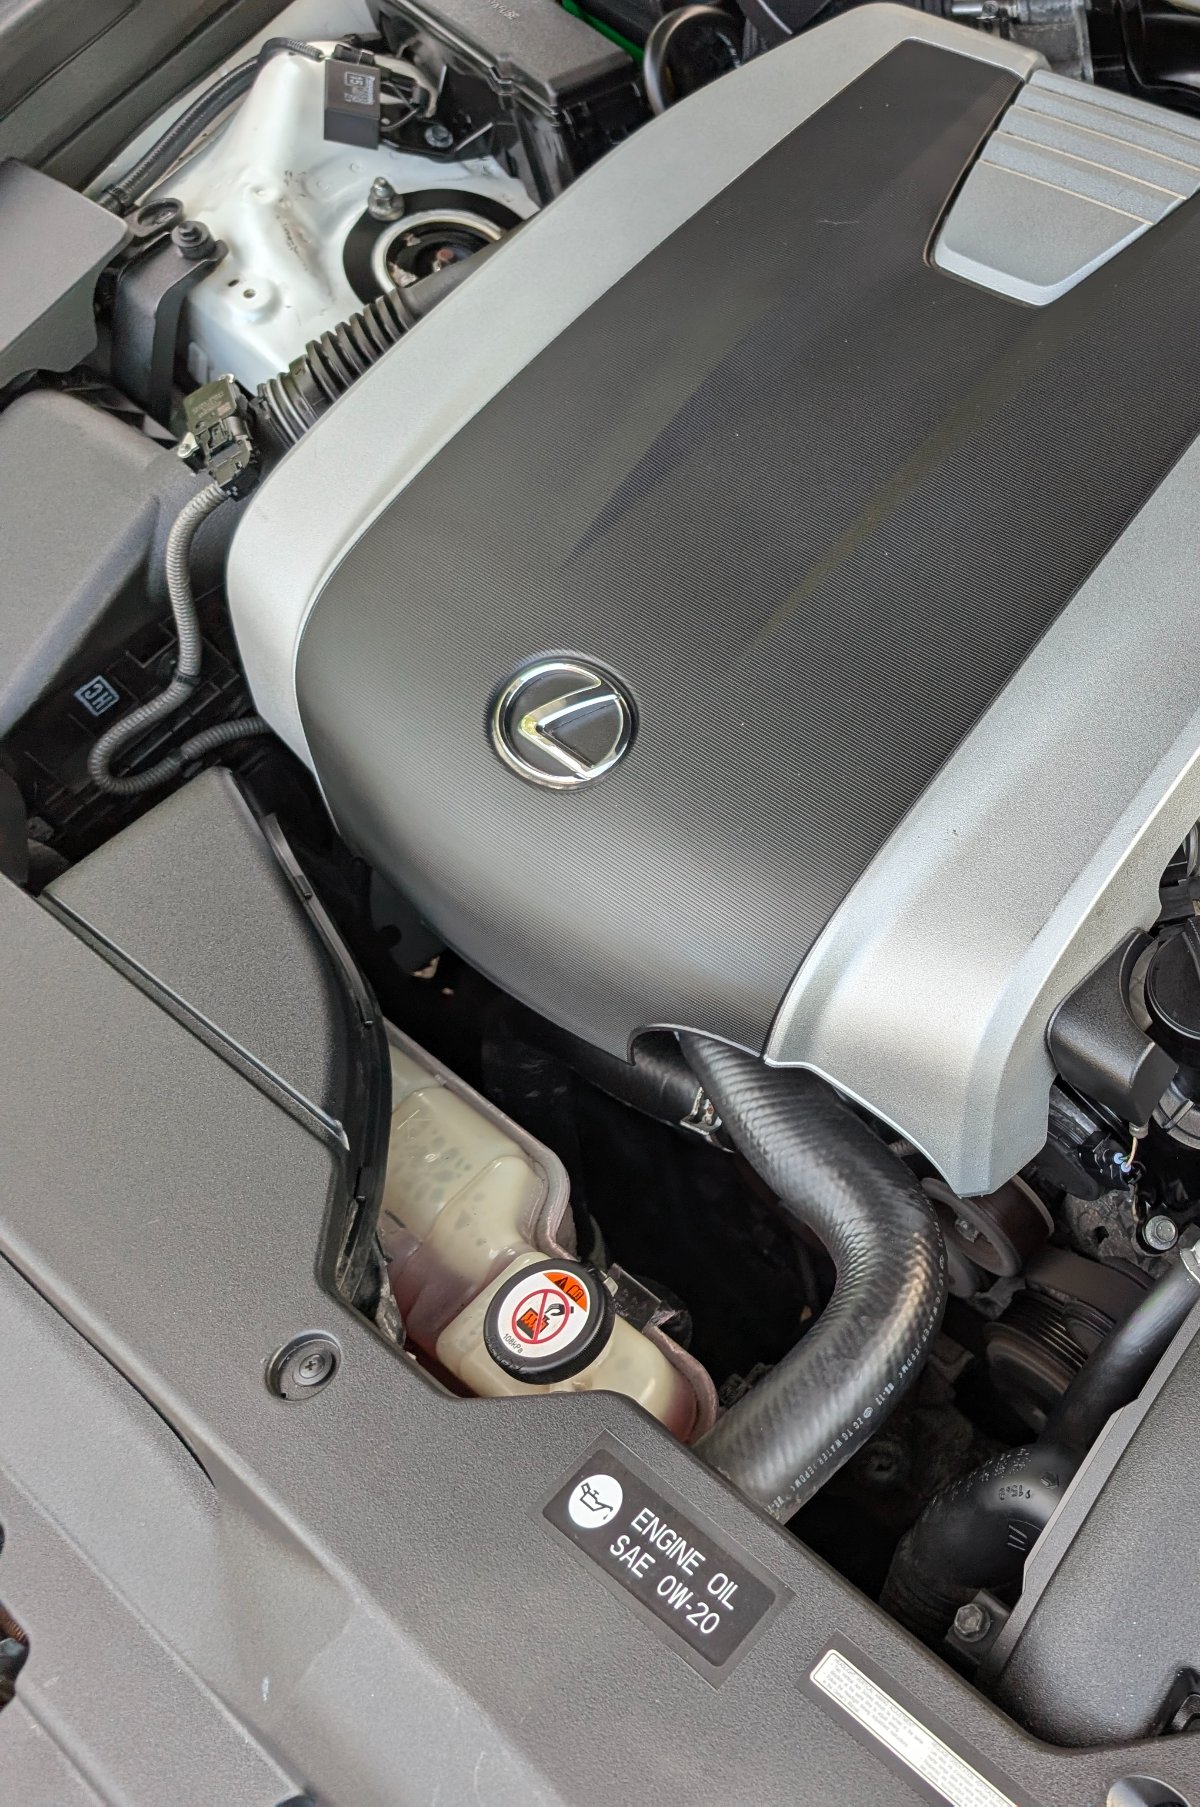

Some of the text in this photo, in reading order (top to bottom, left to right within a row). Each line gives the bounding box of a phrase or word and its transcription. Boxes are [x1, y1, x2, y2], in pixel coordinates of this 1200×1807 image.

[503, 1333, 524, 1354] 108kPa
[609, 1534, 720, 1634] SAE 0W-20
[631, 1507, 739, 1611] ENGINE OIL
